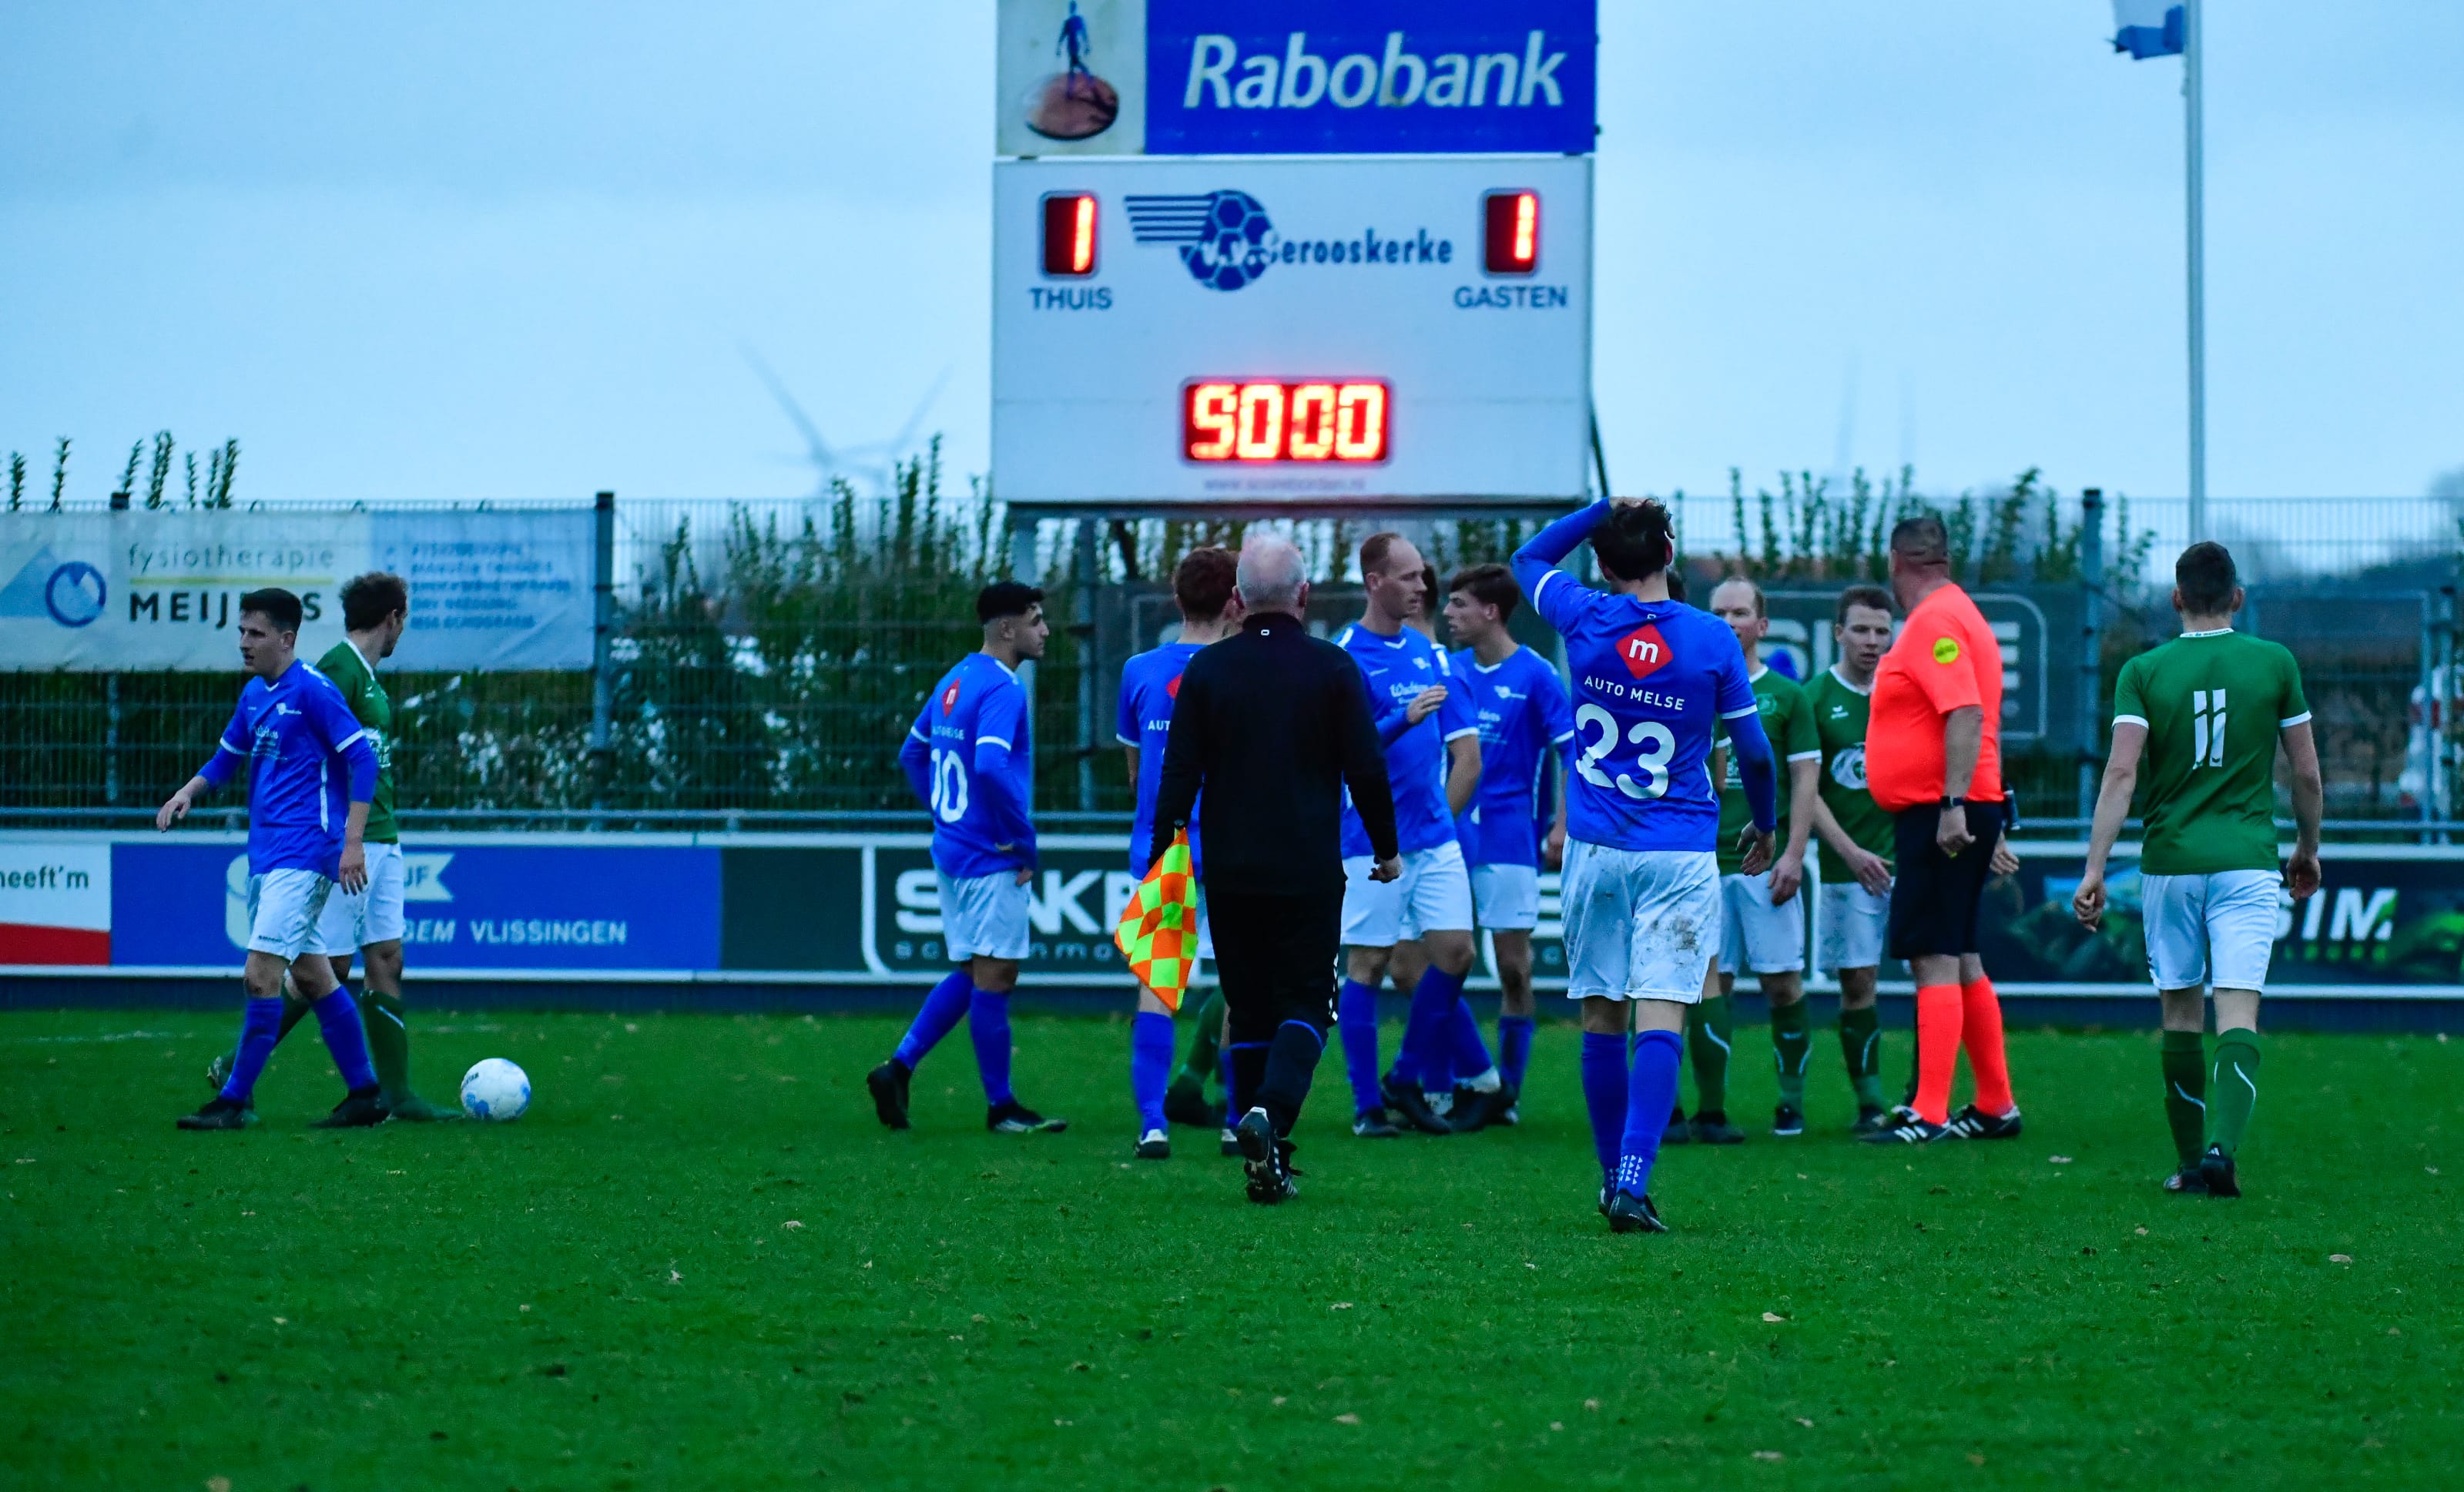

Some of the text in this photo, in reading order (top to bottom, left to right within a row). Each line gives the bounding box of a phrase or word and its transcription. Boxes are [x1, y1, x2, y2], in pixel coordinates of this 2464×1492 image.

[1184, 31, 1567, 109] Rabobank
[1072, 195, 1096, 273] 1
[1514, 193, 1535, 262] 1
[1029, 287, 1113, 310] THUIS
[1453, 285, 1567, 309] GASTEN
[129, 541, 334, 575] fysiotherapie
[129, 592, 322, 630] MEIJS
[1584, 675, 1685, 711] AUTO MELSE
[1148, 719, 1171, 731] AUT
[2192, 688, 2227, 770] 11
[1575, 702, 1676, 800] 23
[930, 748, 968, 823] 10
[469, 919, 629, 944] VLISSINGEN
